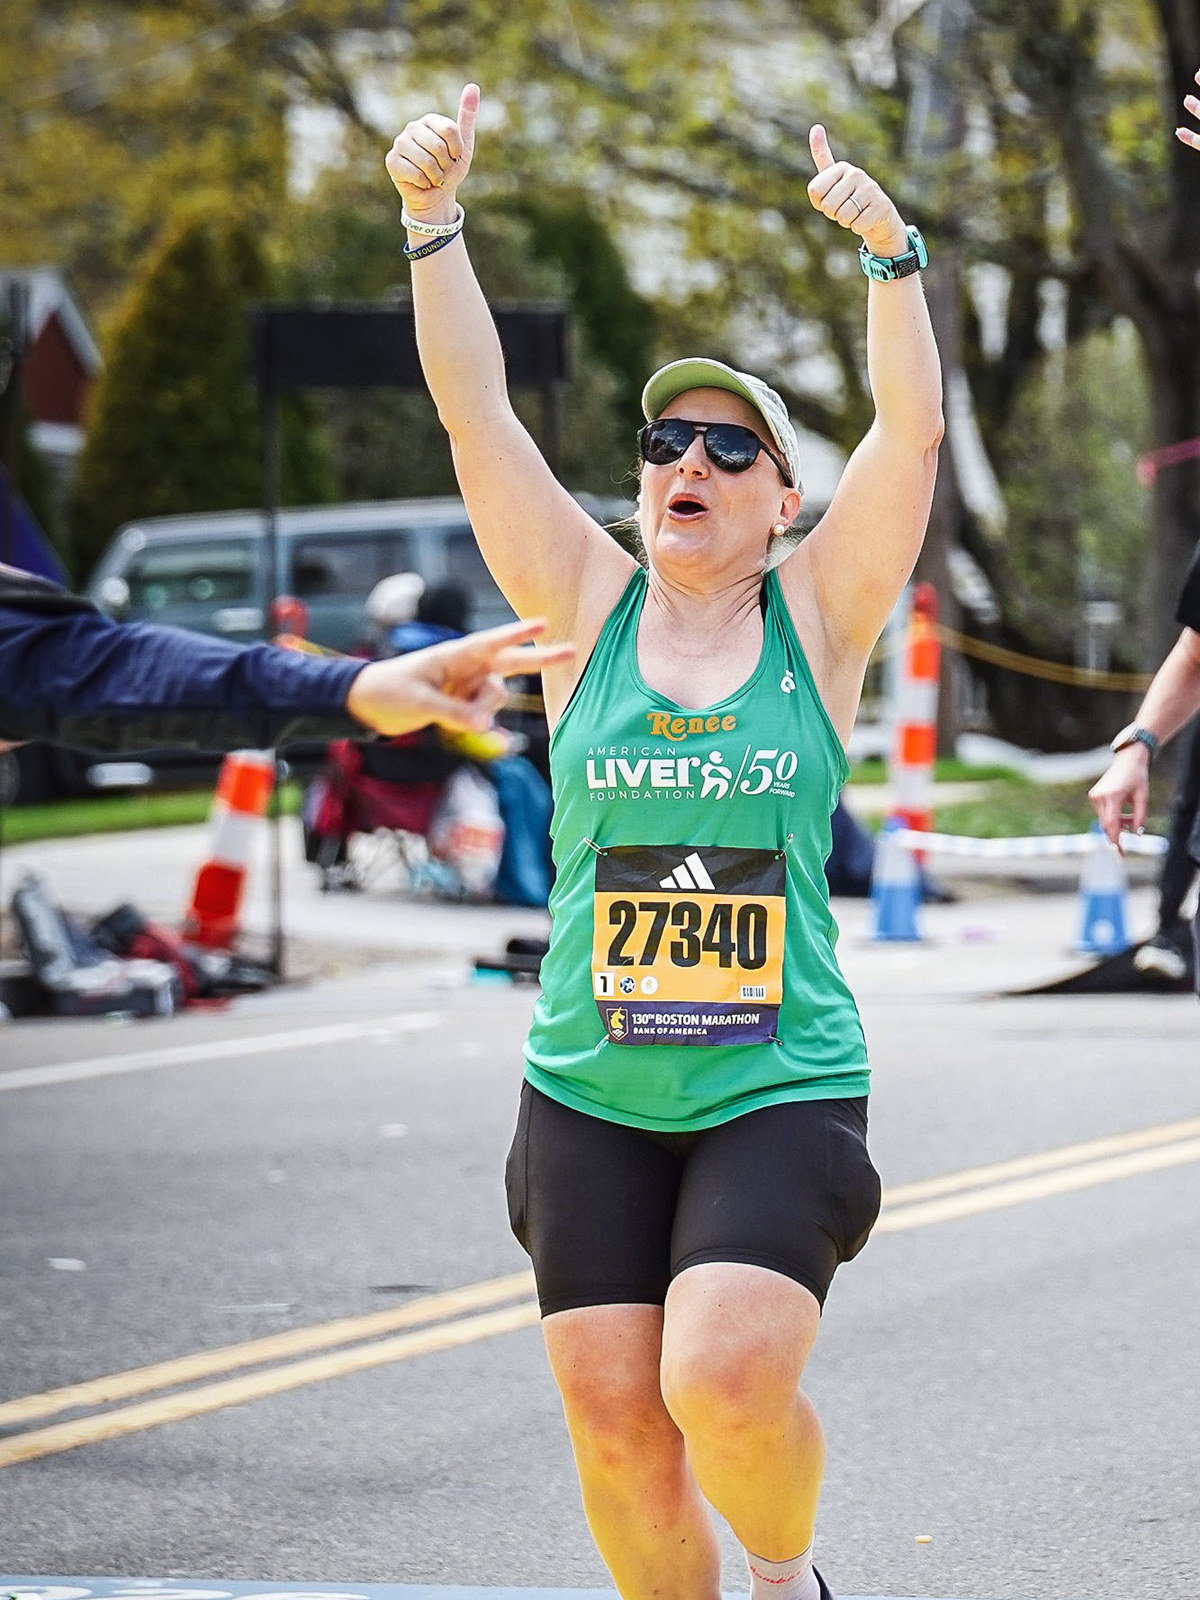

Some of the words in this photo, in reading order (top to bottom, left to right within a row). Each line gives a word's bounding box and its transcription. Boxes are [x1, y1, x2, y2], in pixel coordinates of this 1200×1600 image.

[646, 712, 737, 742] Renee
[586, 746, 677, 756] AMERICAN
[590, 789, 695, 802] FOUNDATION
[606, 899, 768, 970] 27340
[599, 975, 608, 993] 1
[655, 1013, 699, 1026] BOSTON
[701, 1013, 760, 1026] MARATHON
[633, 1027, 655, 1035] BANK
[657, 1027, 668, 1035] OF
[668, 1027, 708, 1036] AMERICA
